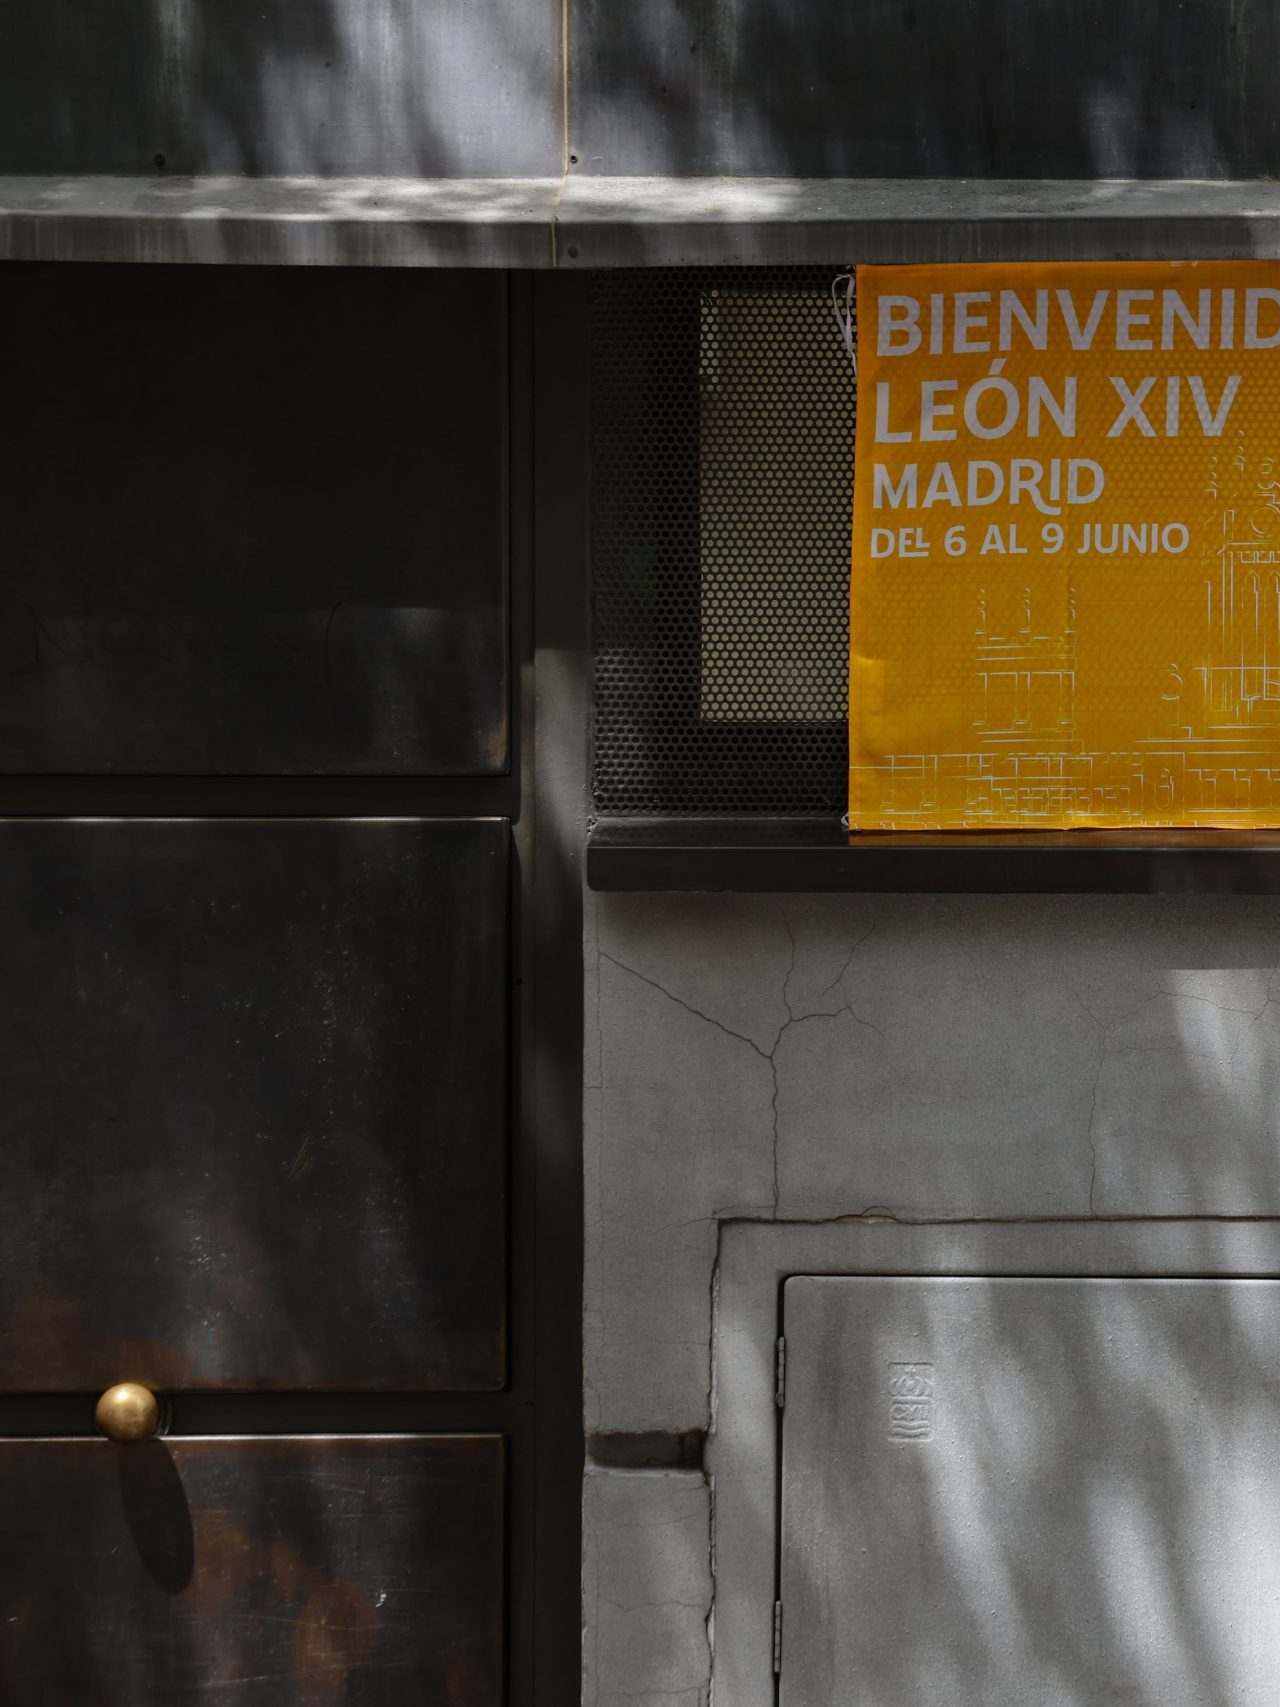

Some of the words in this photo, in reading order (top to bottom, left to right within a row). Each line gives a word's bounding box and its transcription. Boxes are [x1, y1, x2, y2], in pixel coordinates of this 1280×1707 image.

[874, 358, 1077, 443] LEÓN
[1106, 375, 1242, 438] XIV
[873, 458, 1106, 515] MADRID
[870, 527, 930, 558] DEL
[944, 525, 966, 555] 6
[979, 523, 1028, 554] AL
[1041, 522, 1064, 554] 9
[1076, 521, 1190, 554] JUNIO
